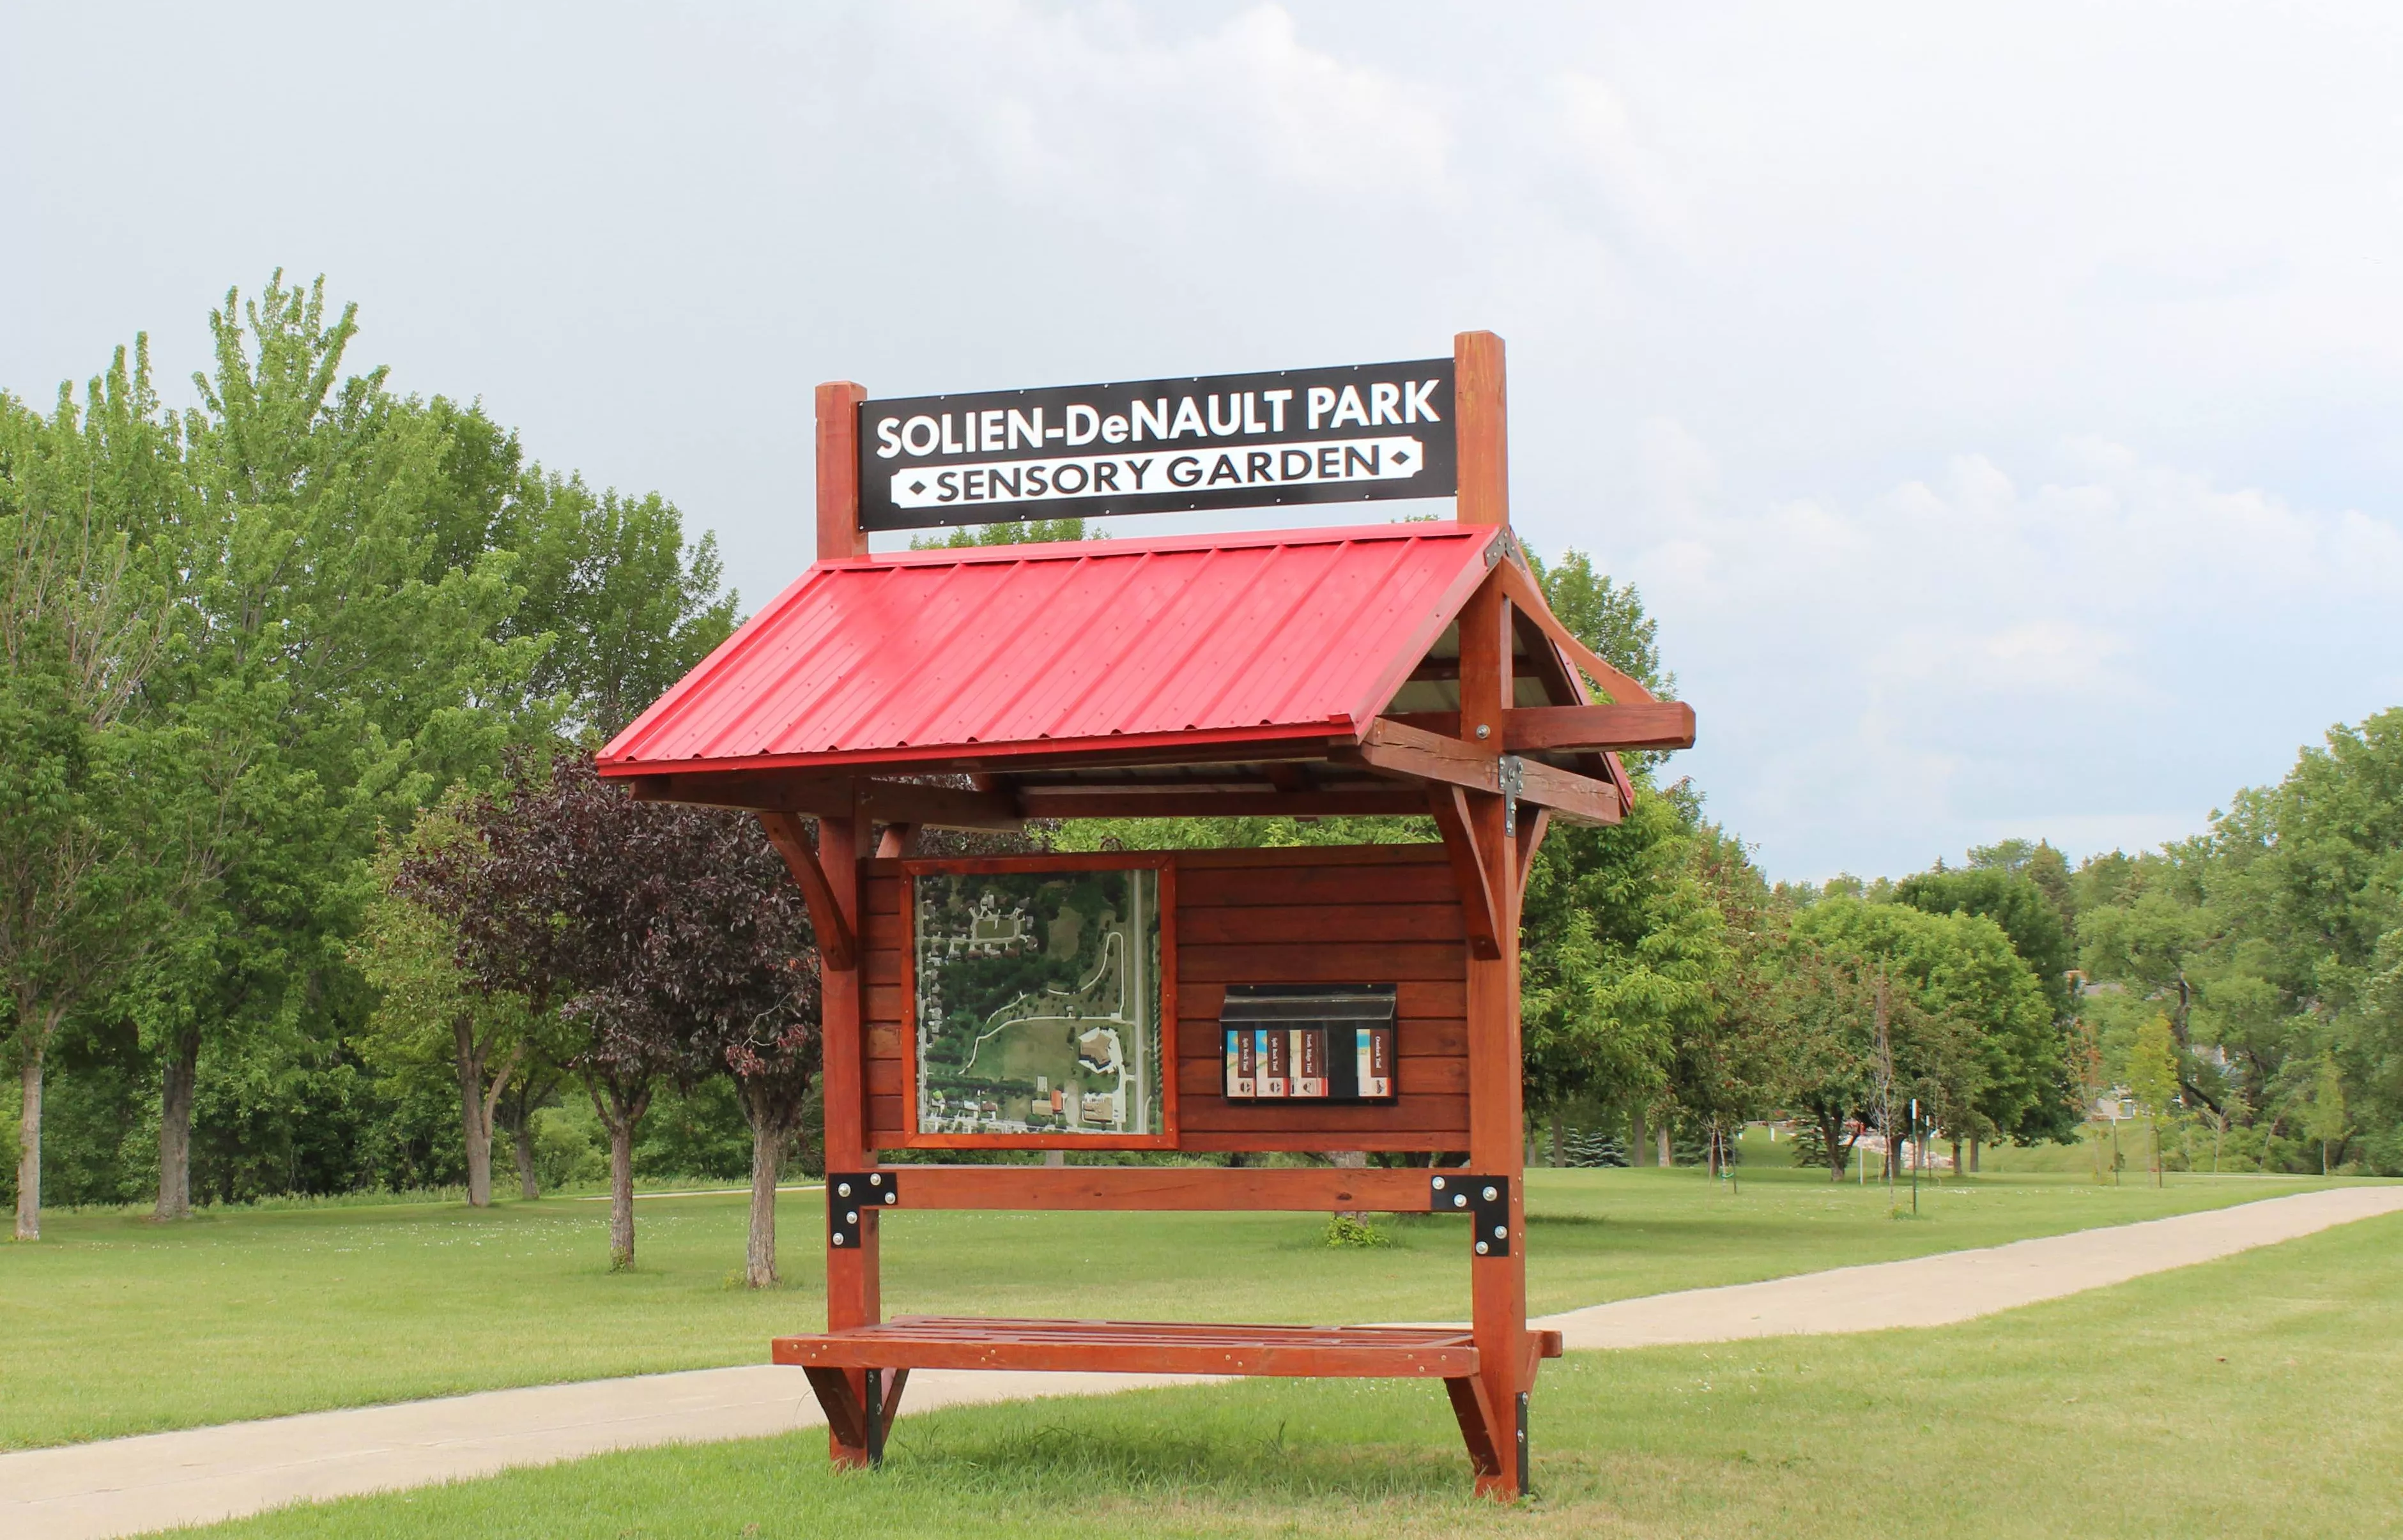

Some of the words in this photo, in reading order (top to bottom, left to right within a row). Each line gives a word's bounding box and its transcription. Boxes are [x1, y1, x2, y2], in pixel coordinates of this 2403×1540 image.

[876, 389, 1293, 459] SOLIEN-DeNAULT
[1308, 379, 1441, 430] PARK
[937, 459, 1153, 502] SENSORY
[1167, 445, 1379, 487] GARDEN
